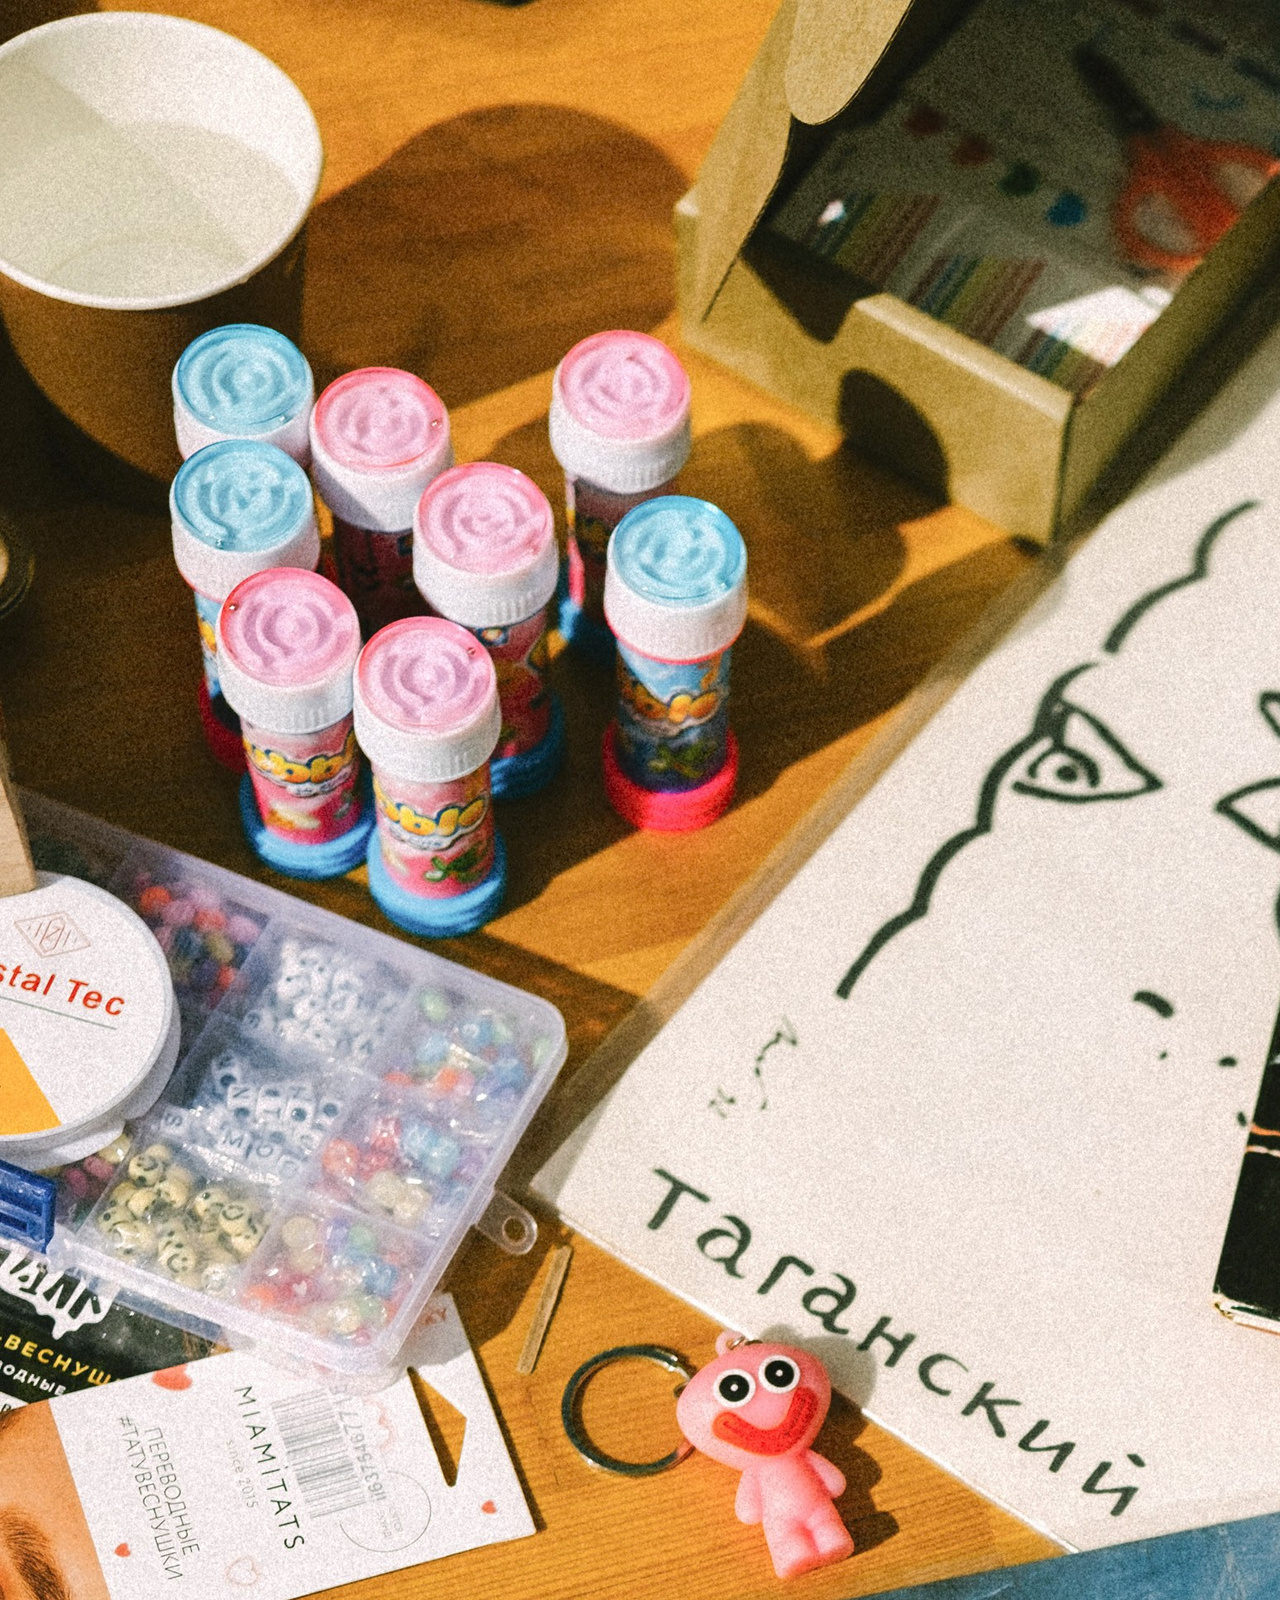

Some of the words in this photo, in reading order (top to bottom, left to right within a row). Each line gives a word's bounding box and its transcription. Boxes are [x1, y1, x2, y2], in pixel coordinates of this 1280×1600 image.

[67, 978, 125, 1016] Tec
[0, 1360, 67, 1396] ОДНЫЕ
[646, 1166, 1147, 1518] Таганский
[119, 1415, 184, 1581] #ТАТУВЕСНУШКИ
[143, 1426, 201, 1556] ПЕРЕВОДНЫЕ
